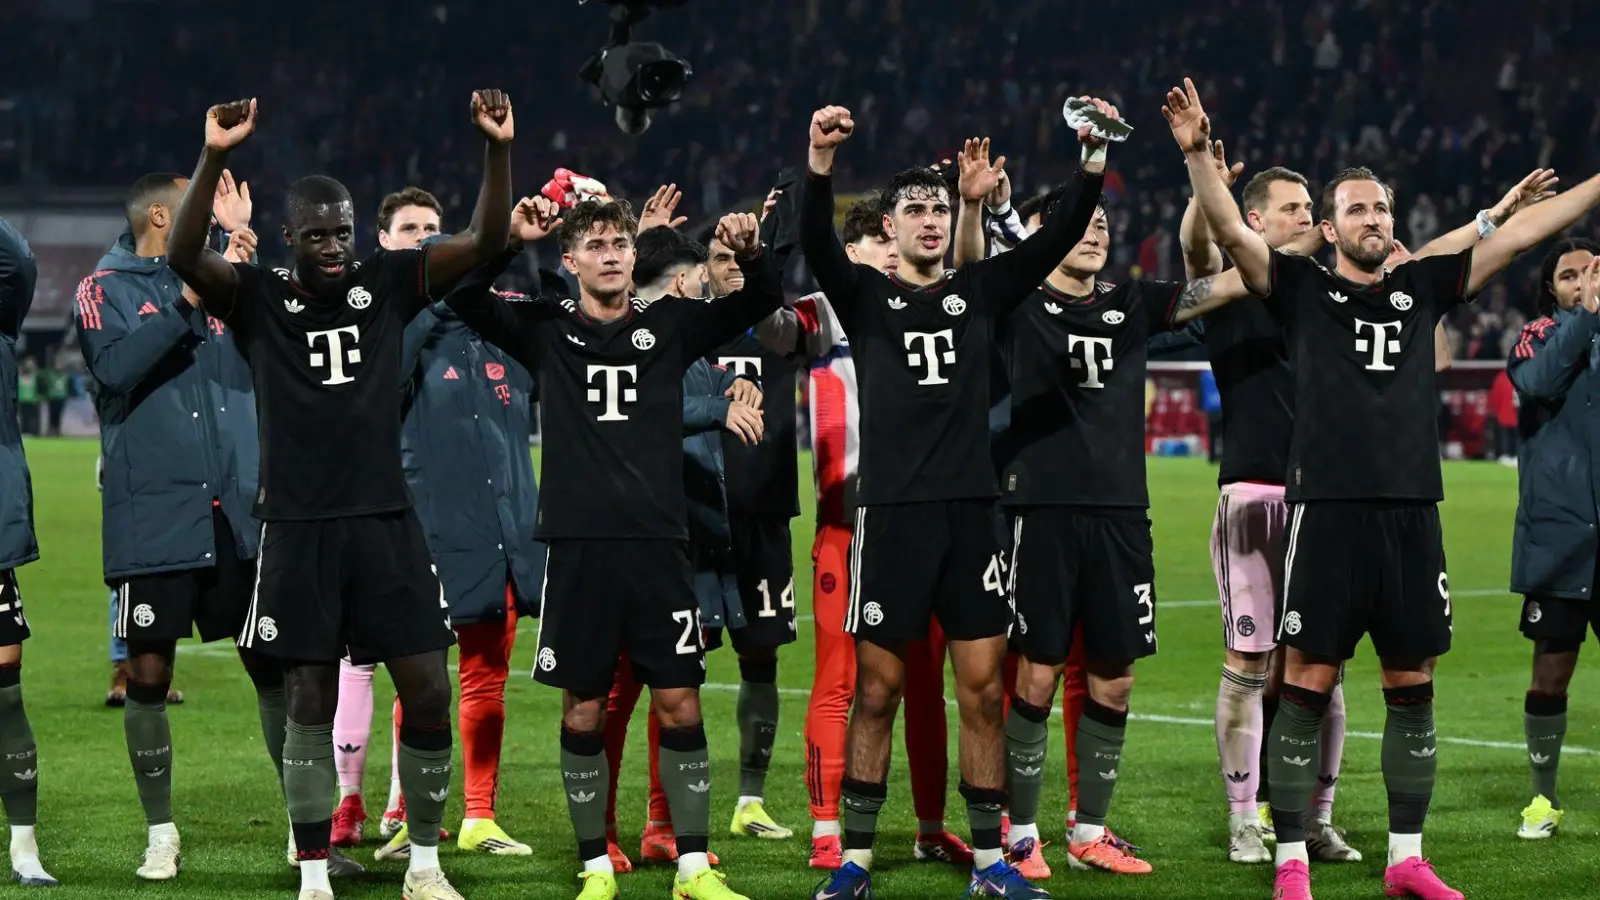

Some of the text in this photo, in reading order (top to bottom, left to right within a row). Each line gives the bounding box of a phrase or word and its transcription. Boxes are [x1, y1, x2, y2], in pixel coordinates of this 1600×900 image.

[306, 325, 361, 386] T
[903, 328, 956, 385] T
[1067, 334, 1113, 389] T
[1355, 317, 1402, 371] T
[586, 364, 638, 421] T
[757, 577, 796, 617] 14
[1133, 583, 1153, 625] 3
[1437, 571, 1451, 616] 9
[564, 770, 598, 780] FCBM
